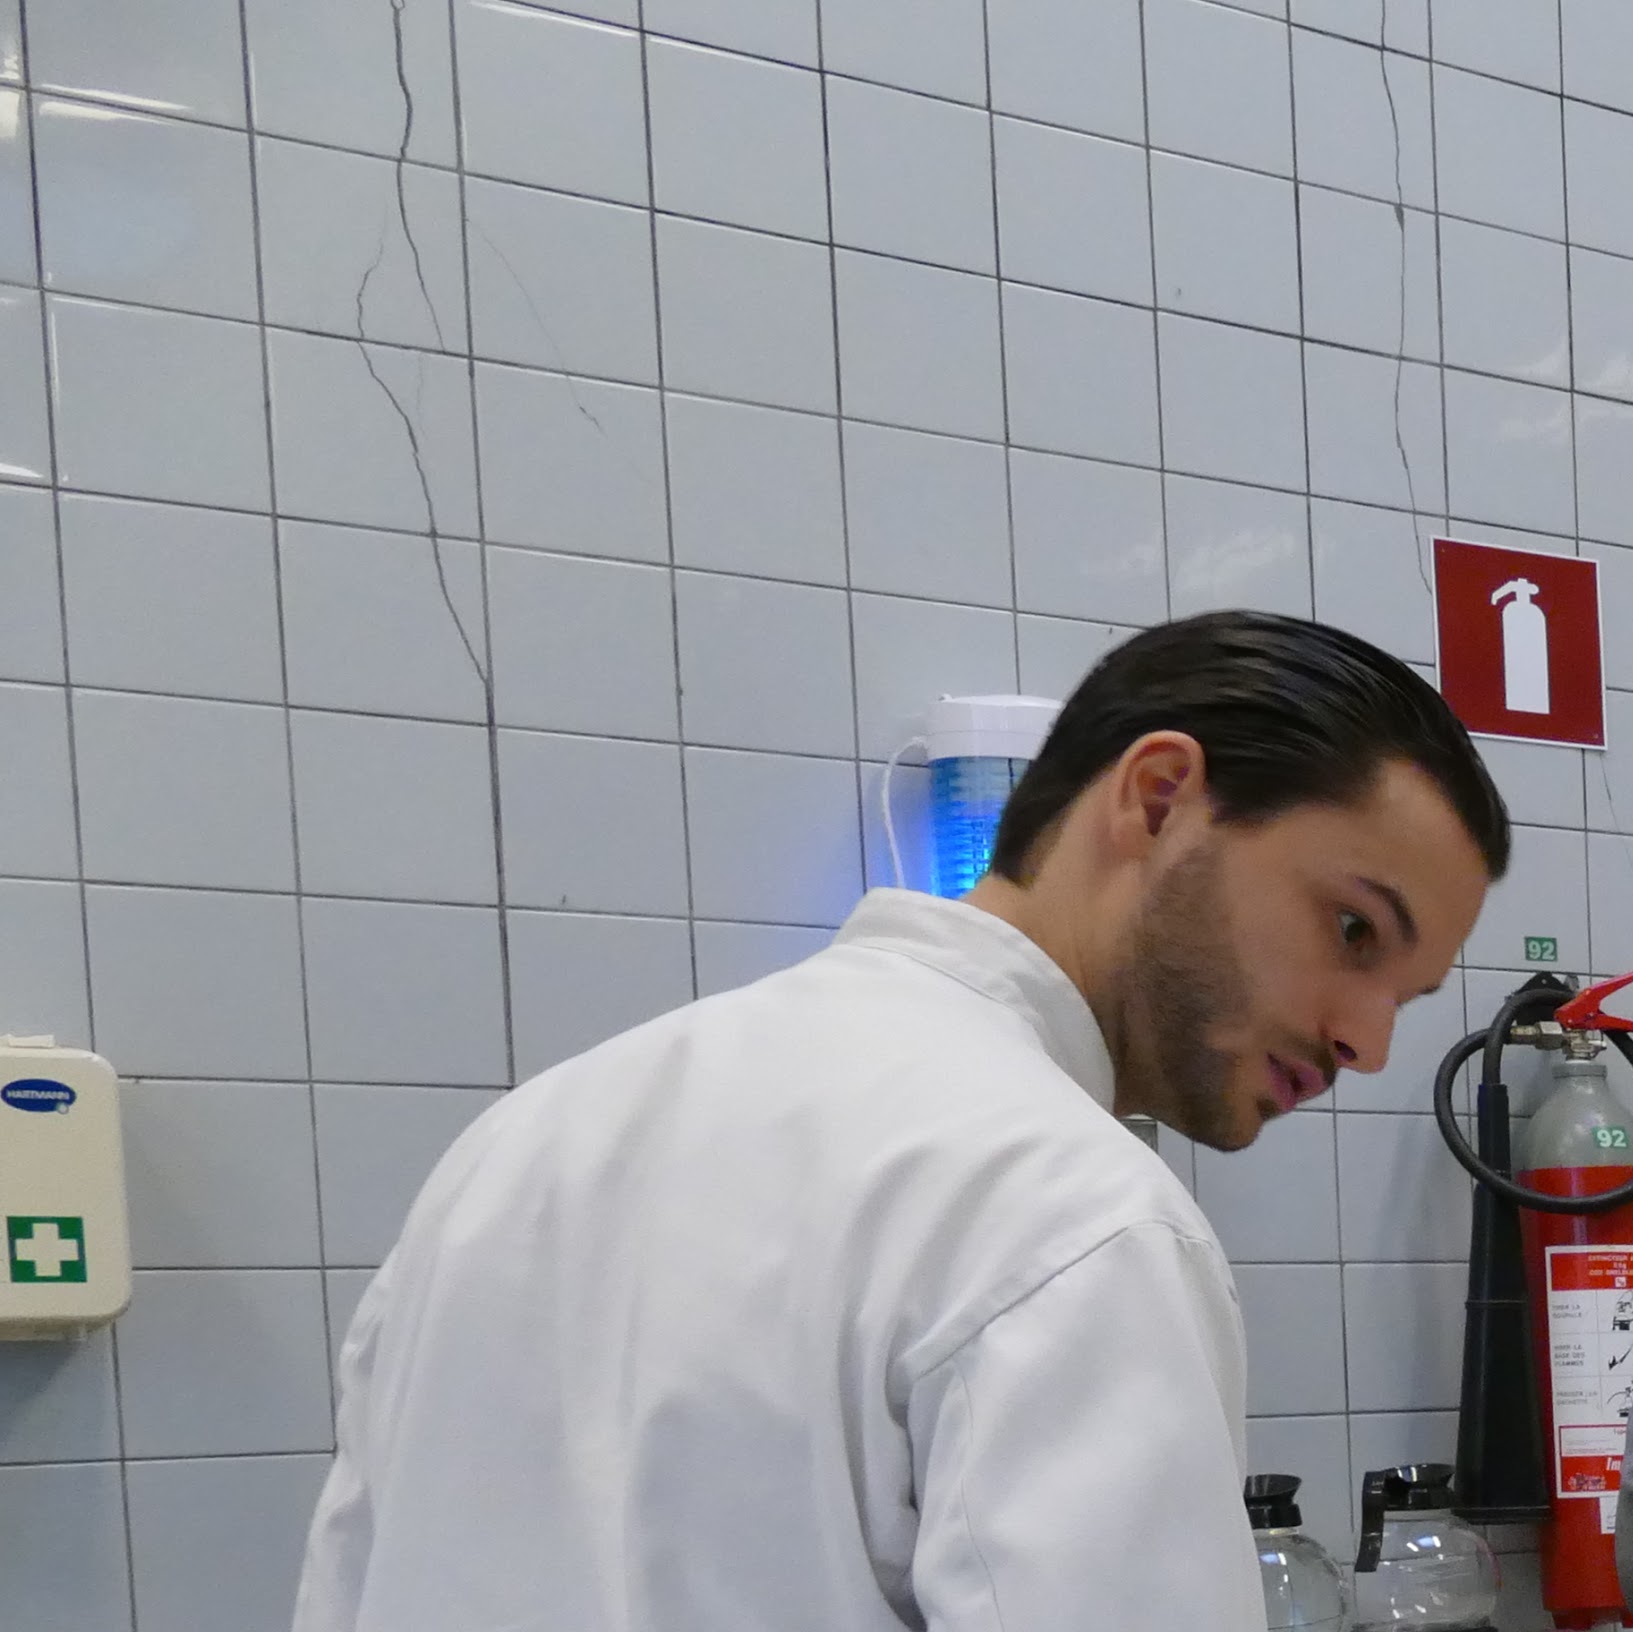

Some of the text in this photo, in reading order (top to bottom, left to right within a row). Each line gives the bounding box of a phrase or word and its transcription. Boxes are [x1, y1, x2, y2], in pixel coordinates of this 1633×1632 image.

[1528, 940, 1556, 960] 92
[6, 1089, 70, 1101] HARTMANN
[1596, 1129, 1627, 1148] 92
